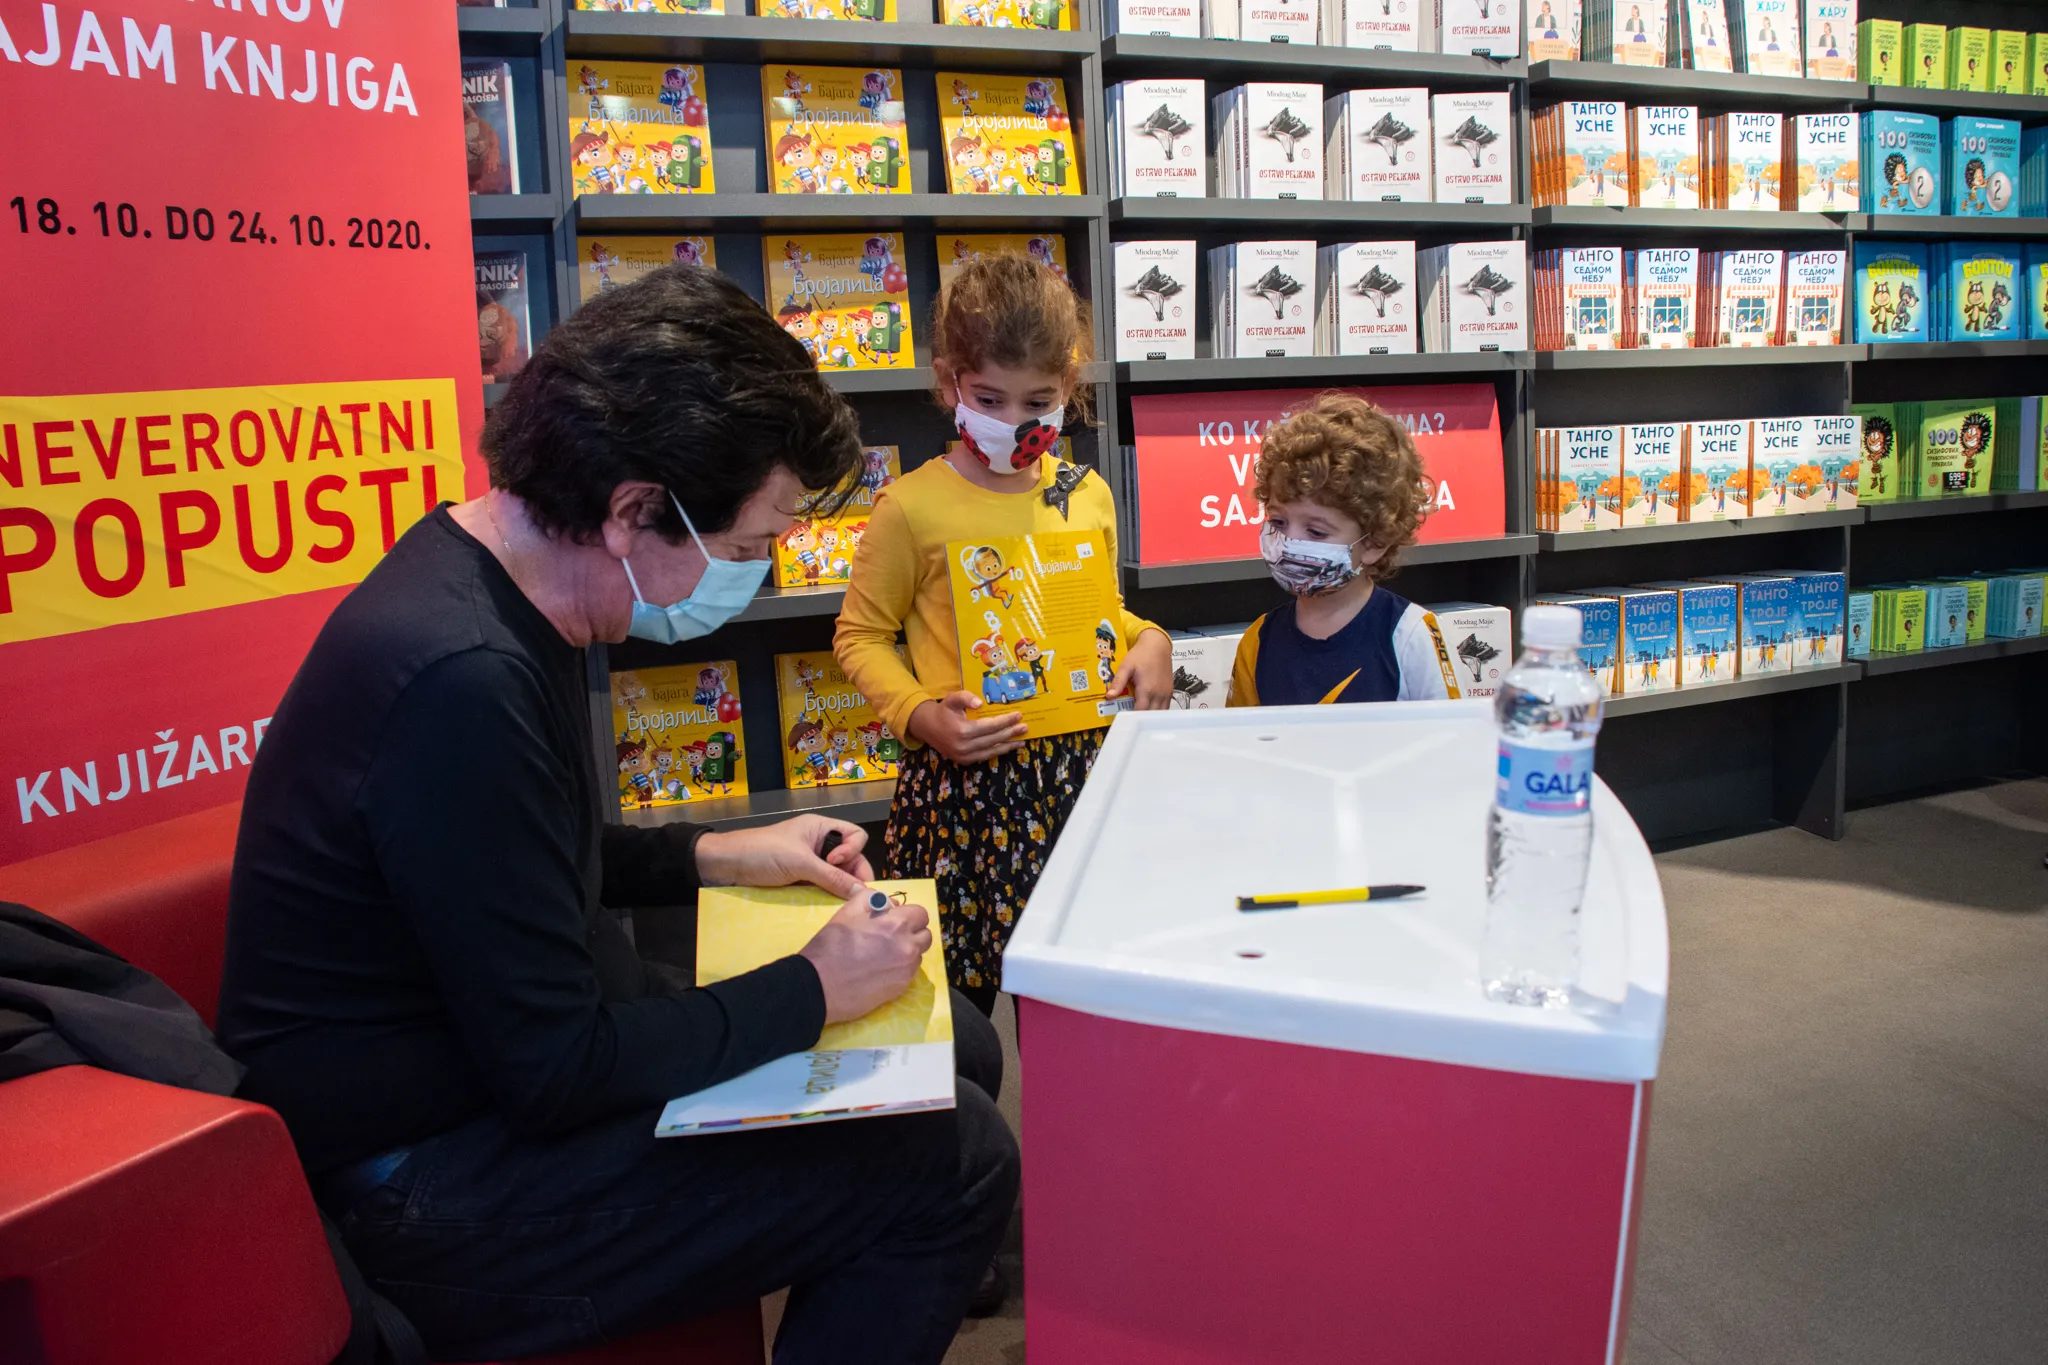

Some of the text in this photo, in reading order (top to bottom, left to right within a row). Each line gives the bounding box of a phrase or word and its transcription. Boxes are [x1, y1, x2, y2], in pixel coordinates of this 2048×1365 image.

[1129, 7, 1191, 17] OSTRVO PELIKANA
[1756, 1, 1786, 13] ЖАРУ
[1818, 6, 1848, 18] ЖАРУ
[1252, 10, 1309, 22] OSTRVO PELIKANA
[1356, 21, 1411, 32] OSTRVO PELIKANA
[1452, 25, 1511, 35] OSTRVO PELIKANA
[200, 31, 419, 116] KNJIGA
[462, 75, 498, 94] NIK
[615, 81, 654, 97] Бајага
[1144, 86, 1170, 95] Miodrag
[818, 85, 855, 100] Бајага
[985, 92, 1020, 106] Бајага
[1267, 91, 1292, 99] Miodrag
[1369, 96, 1394, 104] Miodrag
[1453, 100, 1477, 109] Miodrag
[588, 100, 684, 128] Бројалица
[1571, 102, 1617, 115] ТАНГО
[1645, 107, 1689, 119] ТАНГО
[792, 103, 883, 130] Бројалица
[962, 109, 1048, 134] Бројалица
[1736, 114, 1775, 127] ТАНГО
[1805, 115, 1850, 128] ТАНГО
[1575, 119, 1614, 132] УСНЕ
[1649, 123, 1686, 136] УСНЕ
[1739, 131, 1772, 143] УСНЕ
[1808, 131, 1847, 144] УСНЕ
[1878, 131, 1907, 148] 100
[1962, 136, 1987, 153] 100
[674, 165, 683, 178] 3
[873, 166, 882, 179] 3
[1042, 167, 1050, 177] 3
[1136, 167, 1197, 177] OSTRVO PELIKANA
[1259, 169, 1315, 179] OSTRVO PELIKANA
[1361, 172, 1420, 182] OSTRVO PELIKANA
[1446, 174, 1502, 184] OSTRVO PELIKANA
[1916, 176, 1924, 198] 2
[1994, 179, 2002, 201] 2
[10, 196, 431, 251] 18. 10. DO 24. 10. 2020.
[1135, 248, 1161, 257] Miodrag
[1256, 249, 1282, 257] Miodrag
[1357, 249, 1382, 257] Miodrag
[1467, 249, 1492, 257] Miodrag
[1570, 250, 1614, 261] ТАНГО
[1646, 250, 1690, 262] ТАНГО
[1731, 253, 1774, 264] ТАНГО
[1796, 253, 1837, 265] ТАНГО
[626, 257, 664, 272] Бајага
[818, 254, 855, 269] Бајага
[1574, 266, 1612, 274] СЕДМОМ
[1649, 266, 1688, 274] СЕДМОМ
[1733, 268, 1771, 276] СЕДМОМ
[1798, 268, 1835, 276] СЕДМОМ
[1867, 259, 1920, 279] БОНТОН
[1963, 259, 2014, 279] БОНТОН
[1582, 274, 1604, 283] НЕБУ
[1657, 275, 1679, 283] НЕБУ
[1741, 276, 1762, 284] НЕБУ
[793, 275, 884, 302] Бројалица
[1126, 327, 1186, 338] OSTRVO PELIKANA
[1246, 326, 1306, 336] OSTRVO PELIKANA
[1349, 324, 1408, 334] OSTRVO PELIKANA
[1459, 322, 1518, 331] OSTRVO PELIKANA
[875, 332, 883, 344] 3
[1698, 424, 1741, 436] ТАНГО
[1761, 420, 1802, 433] ТАНГО
[1814, 418, 1854, 430] ТАНГО
[1199, 422, 1234, 447] KO
[1567, 429, 1613, 443] ТАНГО
[1632, 426, 1675, 439] ТАНГО
[1927, 427, 1958, 446] 100
[1764, 436, 1798, 449] УСНЕ
[1817, 433, 1851, 446] УСНЕ
[1570, 446, 1609, 459] УСНЕ
[1634, 442, 1670, 455] УСНЕ
[1701, 440, 1737, 453] УСНЕ
[1009, 568, 1024, 581] 10
[1801, 581, 1839, 594] ТАНГО
[971, 589, 980, 603] 9
[1751, 588, 1789, 602] ТАНГО
[1690, 595, 1730, 609] ТАНГО
[1801, 599, 1838, 612] ТРОЈЕ
[1583, 609, 1611, 622] НГО
[1631, 601, 1671, 617] ТАНГО
[1751, 606, 1788, 619] ТРОЈЕ
[984, 610, 1001, 632] 8
[1690, 613, 1730, 628] ТРОЈЕ
[1632, 620, 1671, 635] ТРОЈЕ
[1584, 629, 1610, 641] ОЈЕ
[1041, 649, 1056, 671] 7
[652, 687, 690, 702] Бајага
[627, 707, 718, 737] Бројалица
[884, 744, 892, 755] 3
[710, 763, 718, 774] 3
[1525, 770, 1588, 795] GALA
